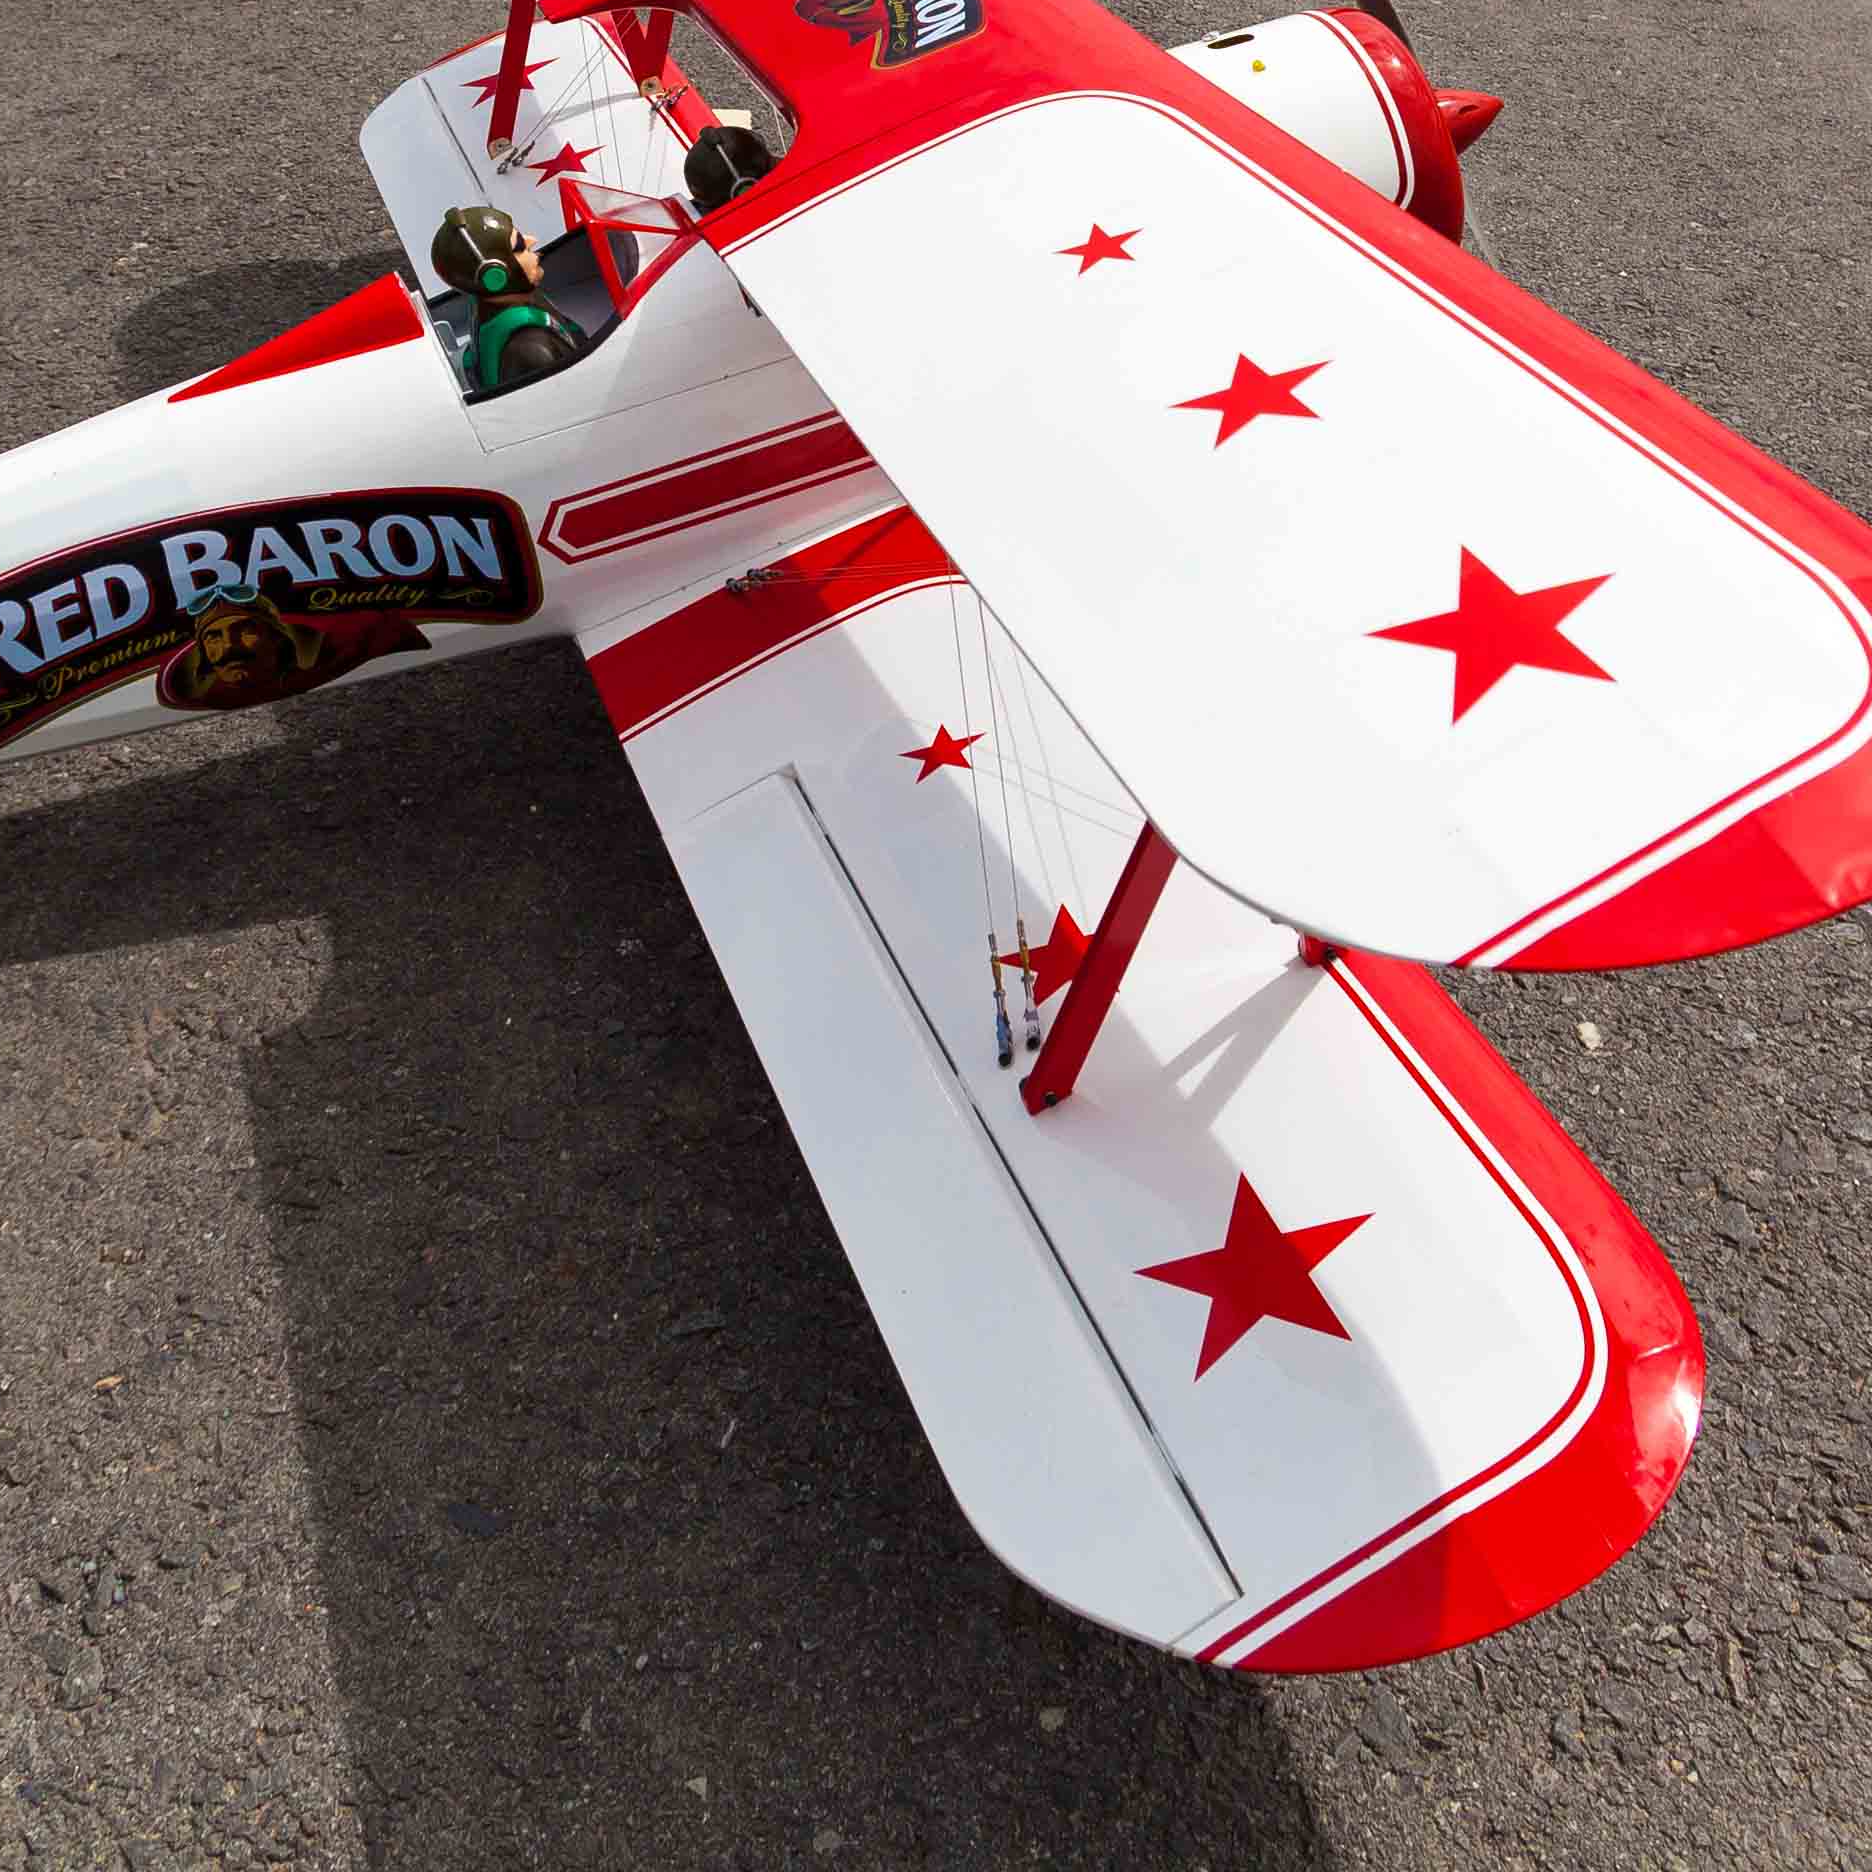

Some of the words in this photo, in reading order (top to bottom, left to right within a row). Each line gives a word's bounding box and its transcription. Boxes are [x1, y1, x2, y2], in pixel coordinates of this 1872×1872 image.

[159, 514, 503, 610] BARON
[36, 629, 178, 700] Premium
[307, 584, 426, 611] Quality
